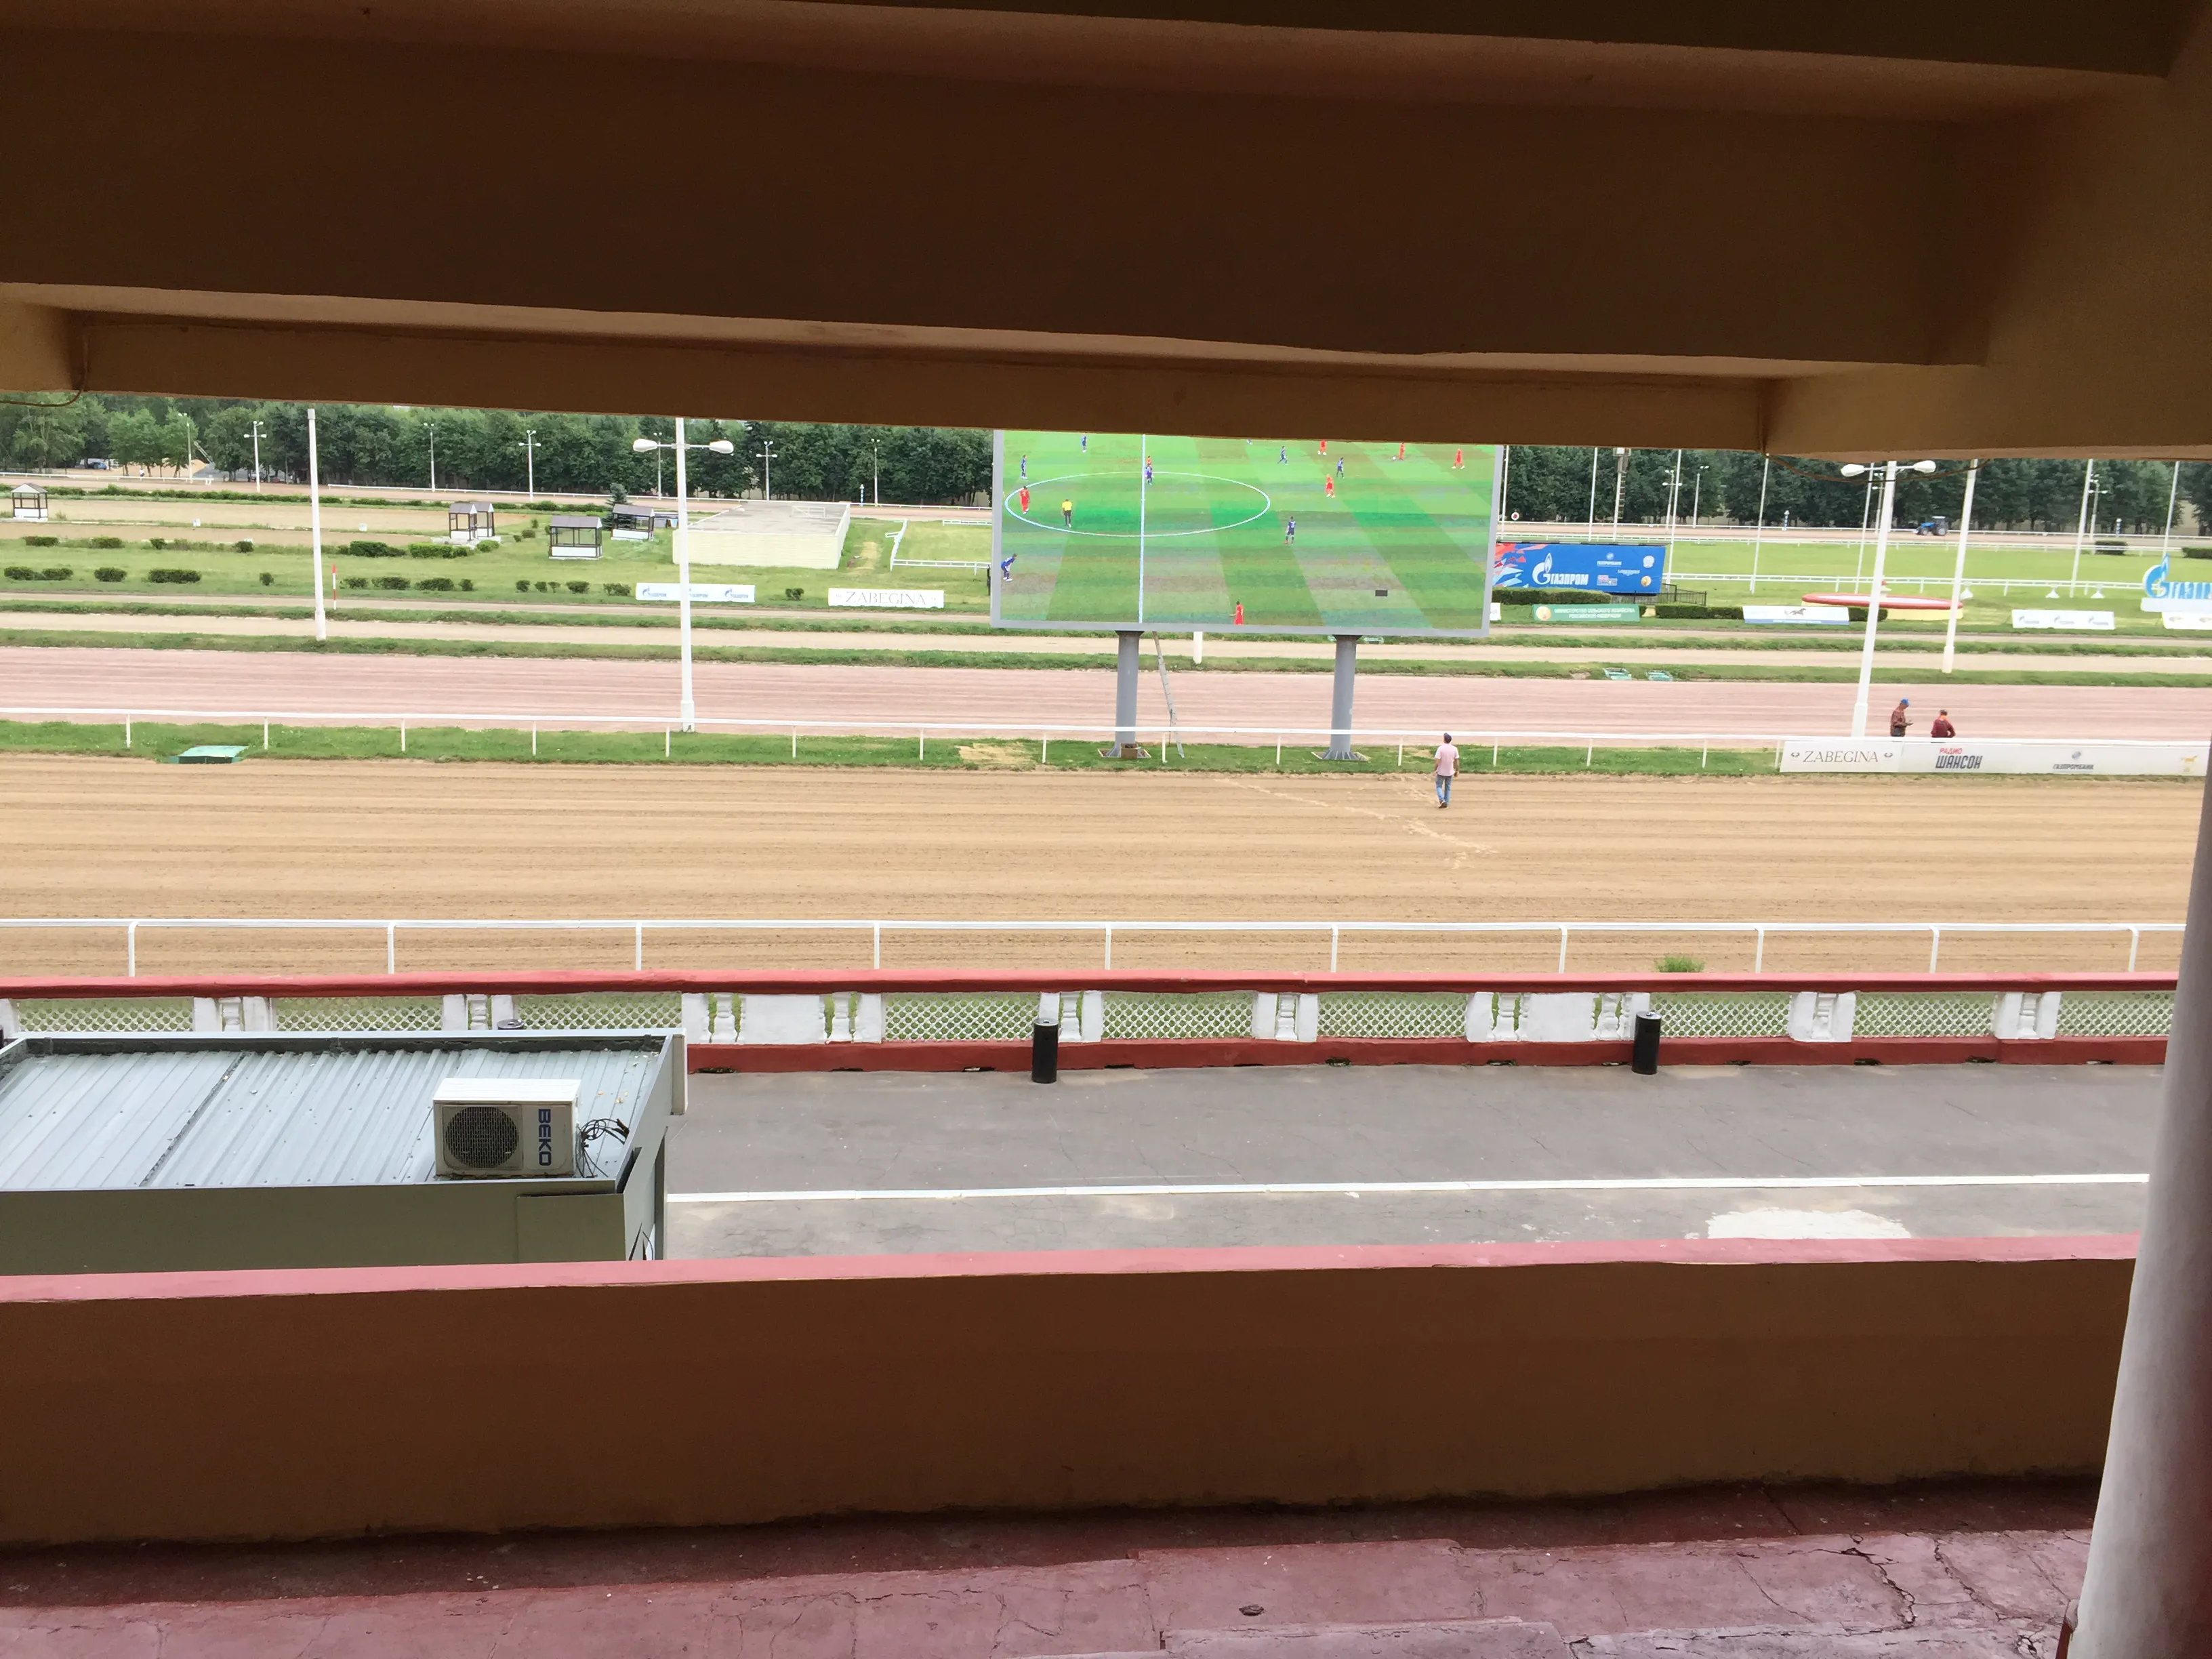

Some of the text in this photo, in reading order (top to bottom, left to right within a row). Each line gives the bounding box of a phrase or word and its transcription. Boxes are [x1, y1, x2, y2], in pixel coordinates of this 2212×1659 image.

[1550, 573, 1589, 586] ГАЗПРОМ
[846, 592, 926, 605] ZABEGINA
[1803, 751, 1879, 762] ZABEGINA
[1935, 755, 1983, 769] ШАНСОН
[538, 1108, 552, 1166] BEKO
